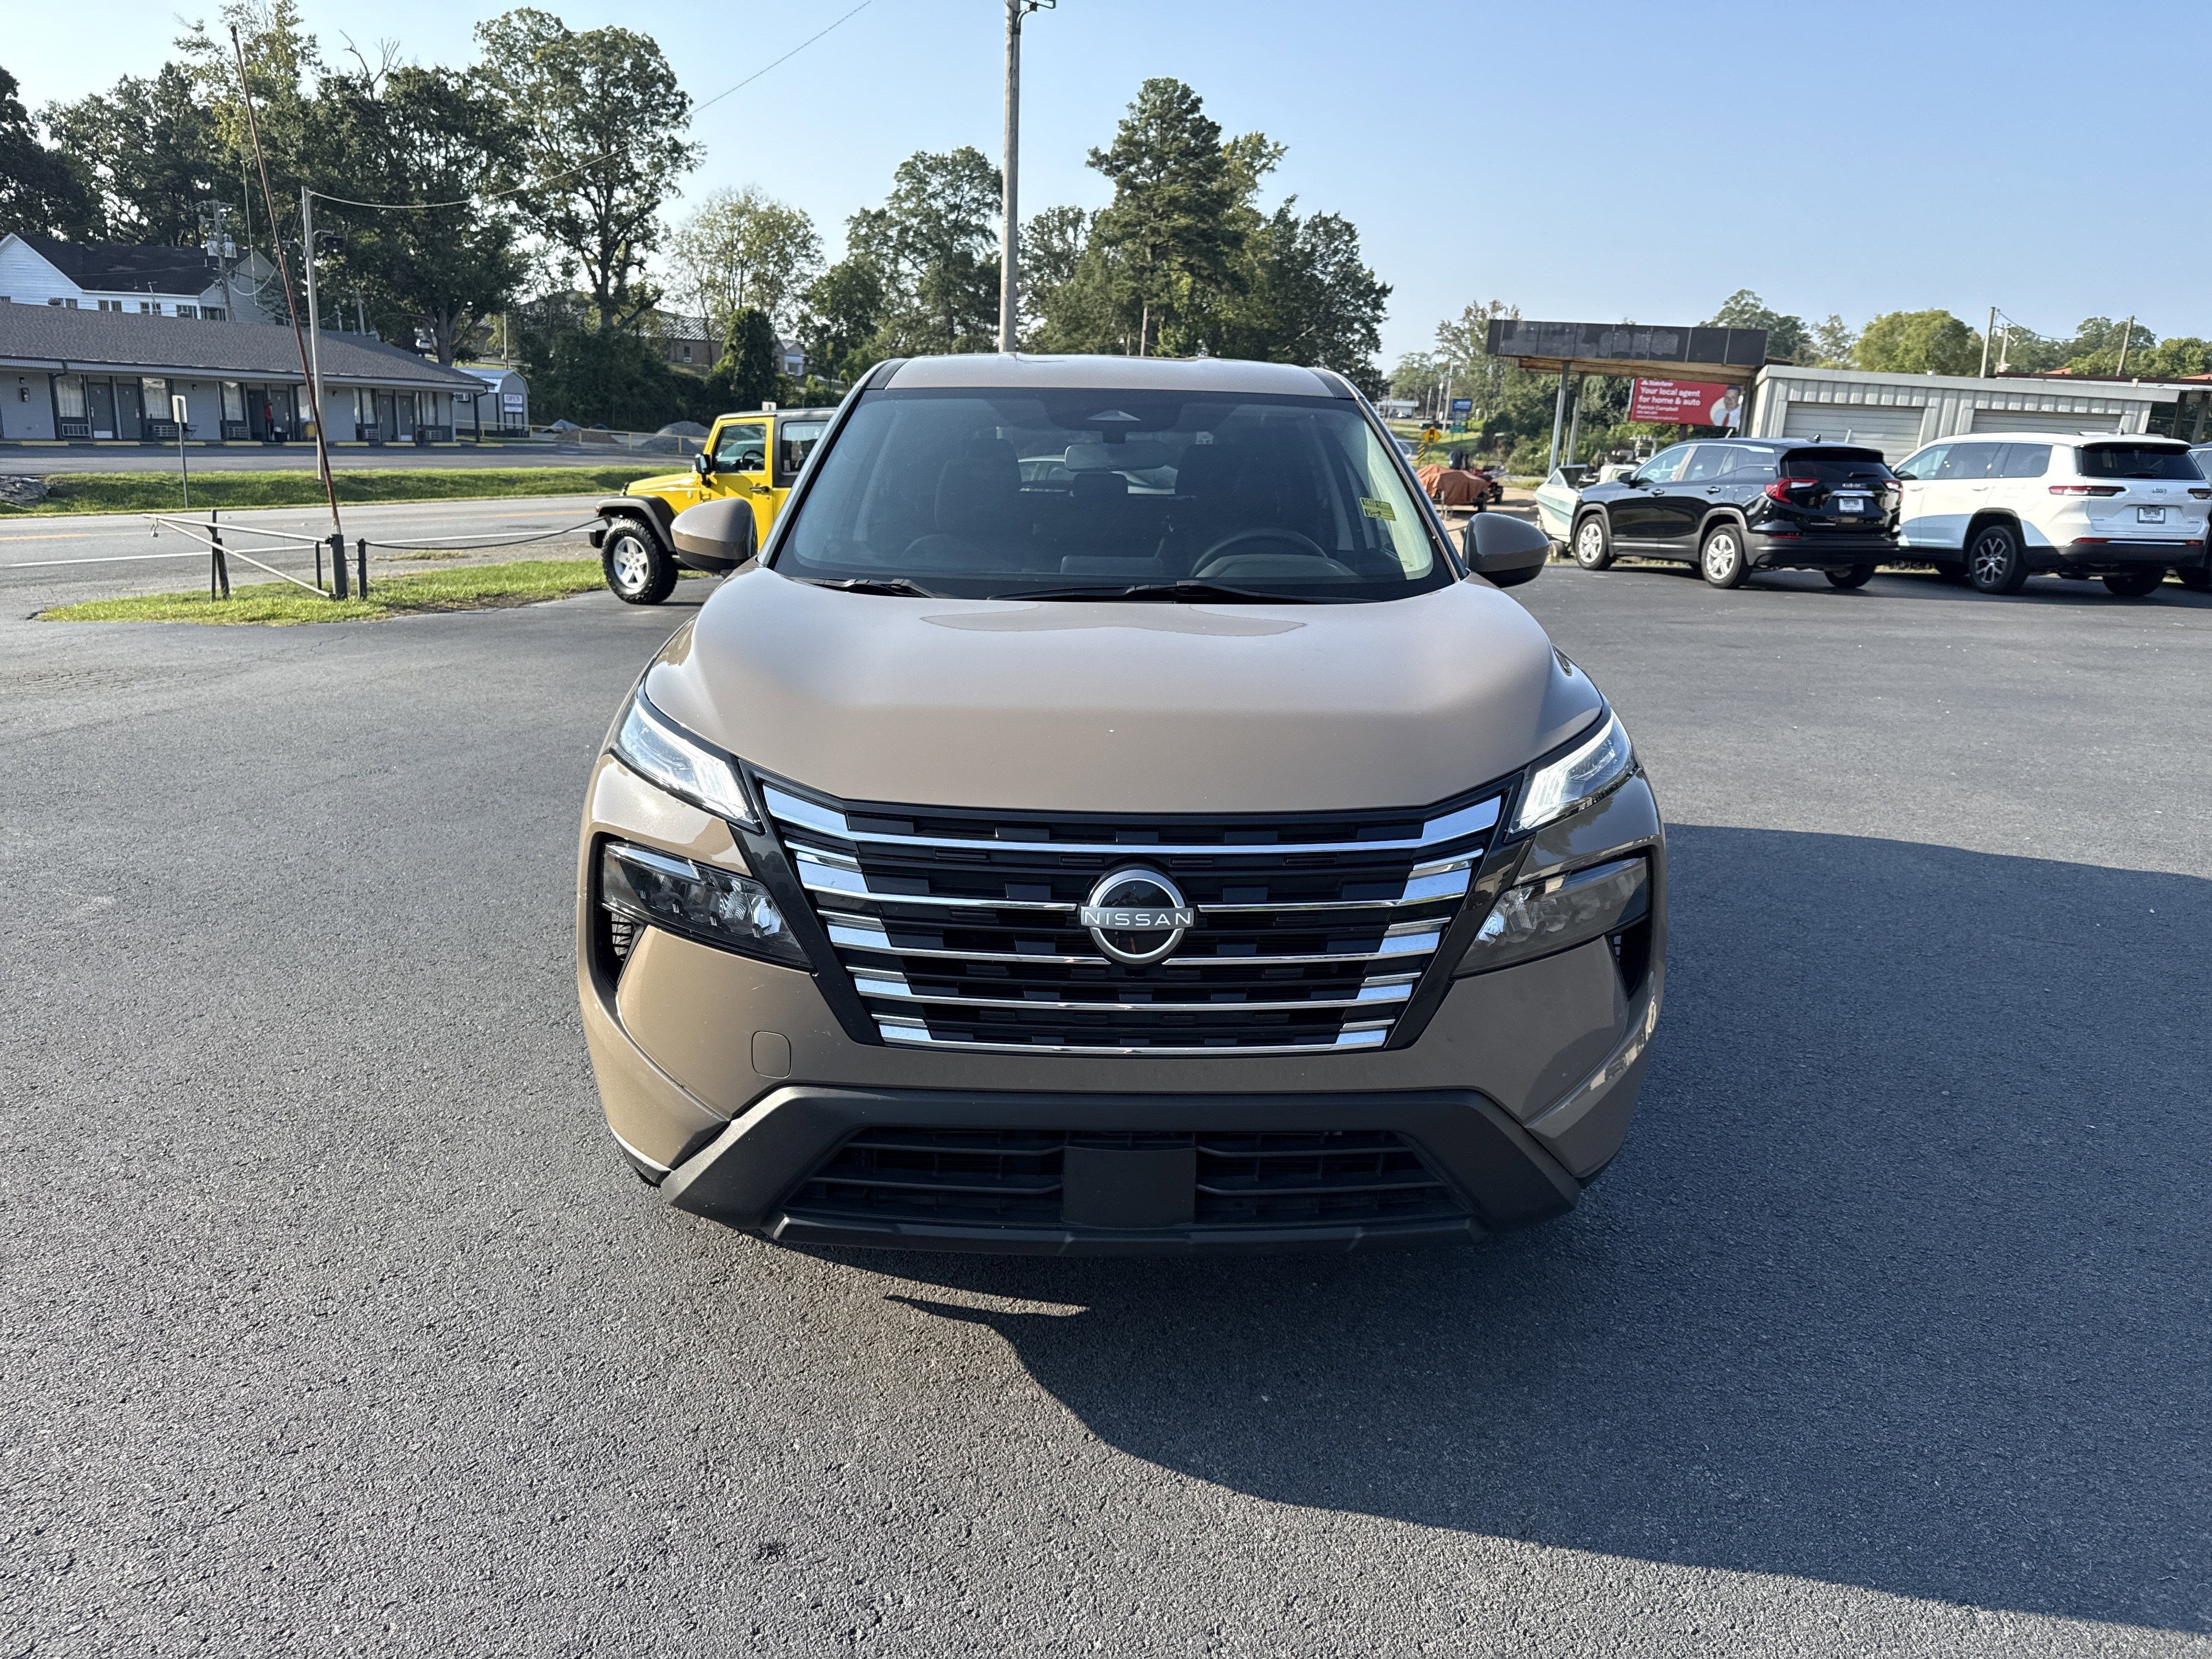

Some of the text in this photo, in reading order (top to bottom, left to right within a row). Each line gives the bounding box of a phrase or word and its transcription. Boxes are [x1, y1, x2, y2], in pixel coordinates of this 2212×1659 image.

[1659, 387, 1678, 396] local
[1639, 394, 1650, 403] for
[1651, 396, 1674, 404] home
[1084, 911, 1191, 927] NISSAN
